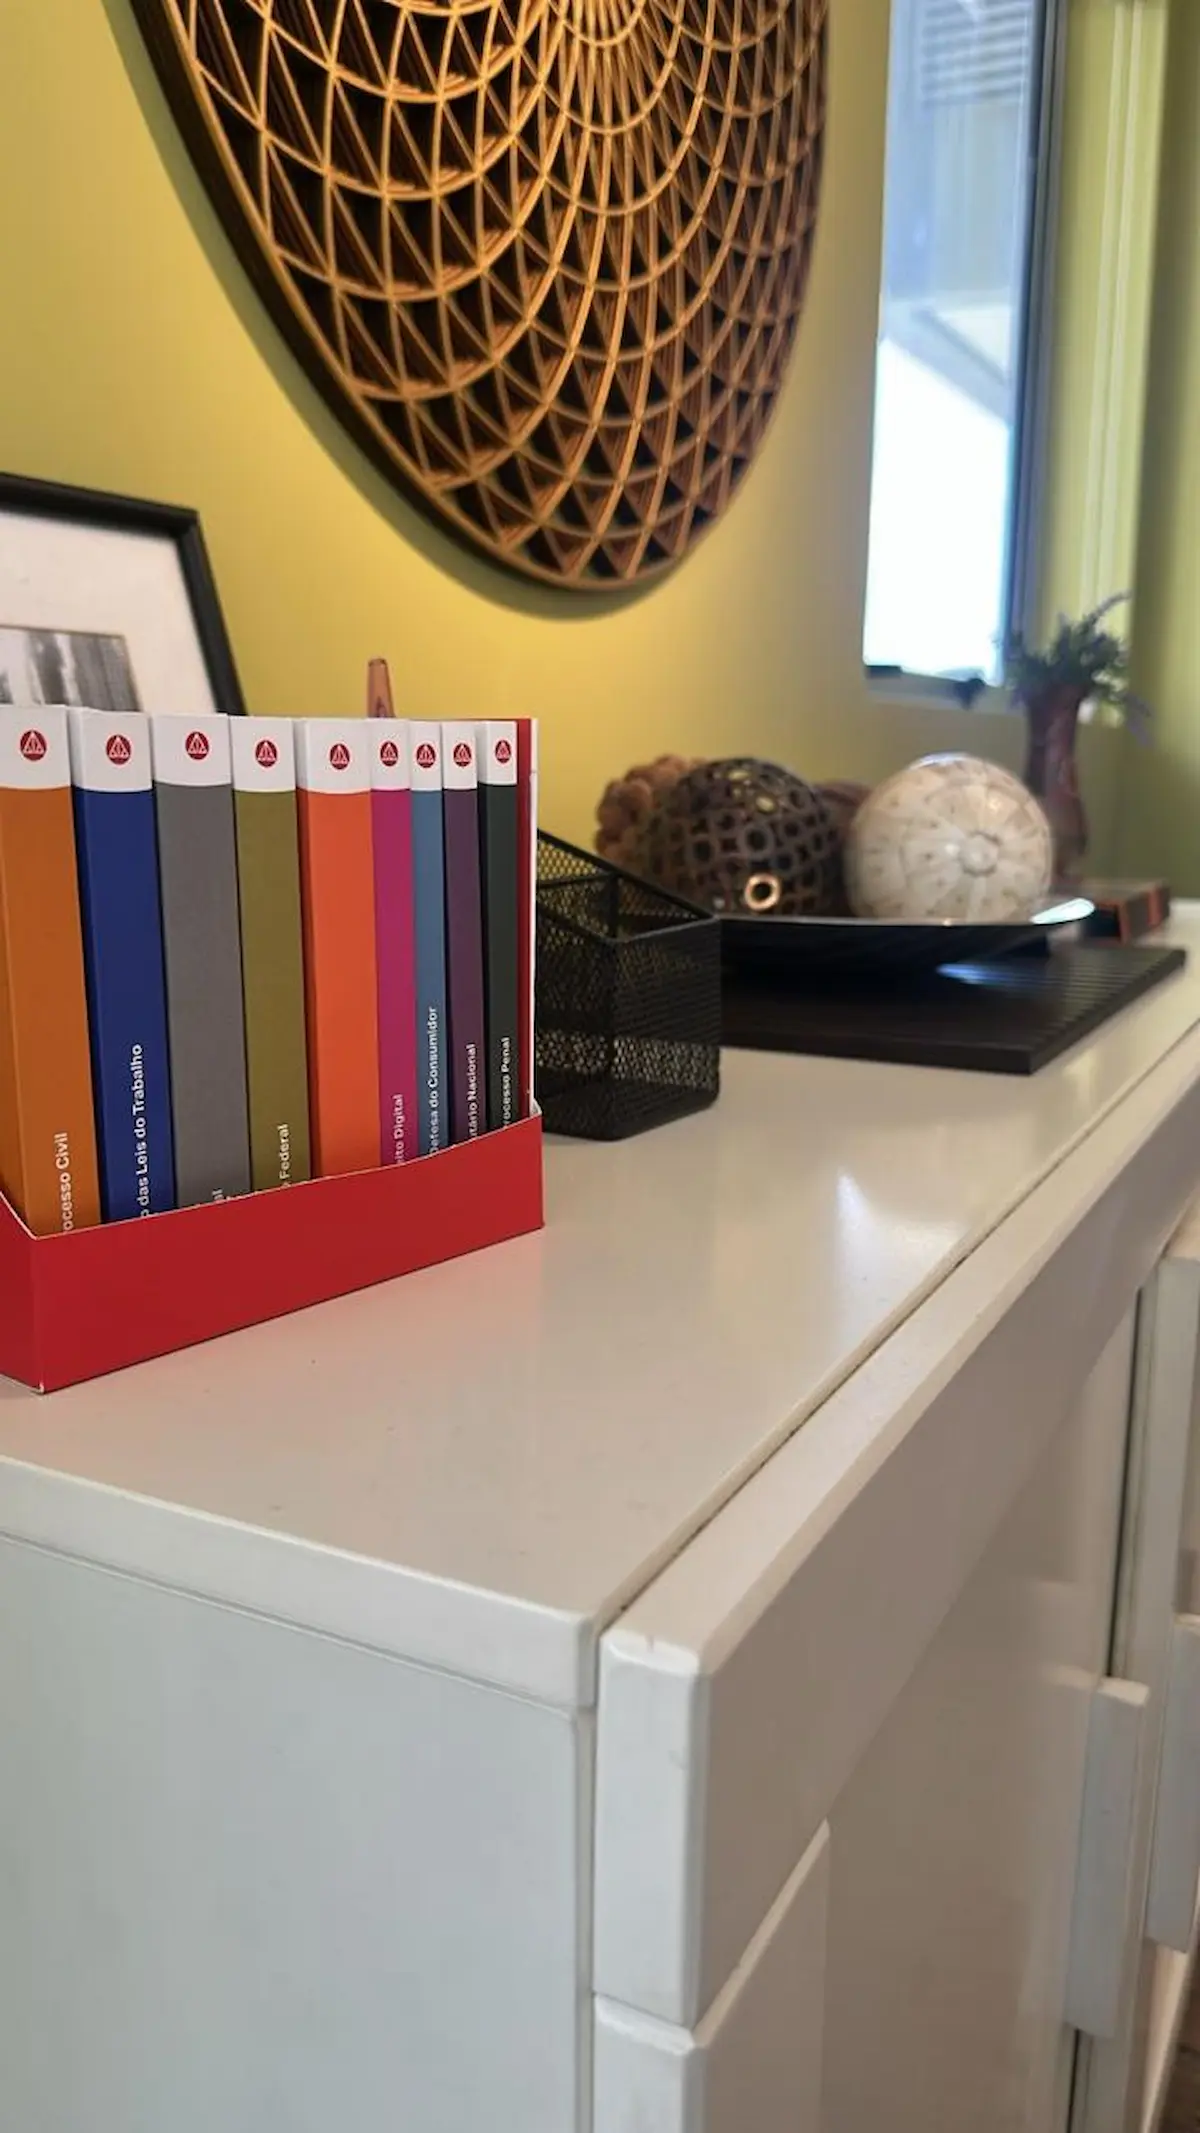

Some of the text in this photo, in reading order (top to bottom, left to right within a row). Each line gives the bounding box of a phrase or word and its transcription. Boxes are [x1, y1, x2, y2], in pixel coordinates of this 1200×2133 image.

[427, 1006, 439, 1088] Consumidor
[500, 1036, 511, 1073] Penal
[130, 1043, 145, 1116] Trabalho
[465, 1043, 478, 1101] Nacional
[392, 1093, 405, 1140] Digital
[429, 1090, 440, 1108] do
[134, 1117, 146, 1139] do
[277, 1123, 291, 1180] Federal
[54, 1132, 74, 1231] ocesso Civil
[134, 1141, 148, 1175] Leis
[136, 1176, 149, 1206] das
